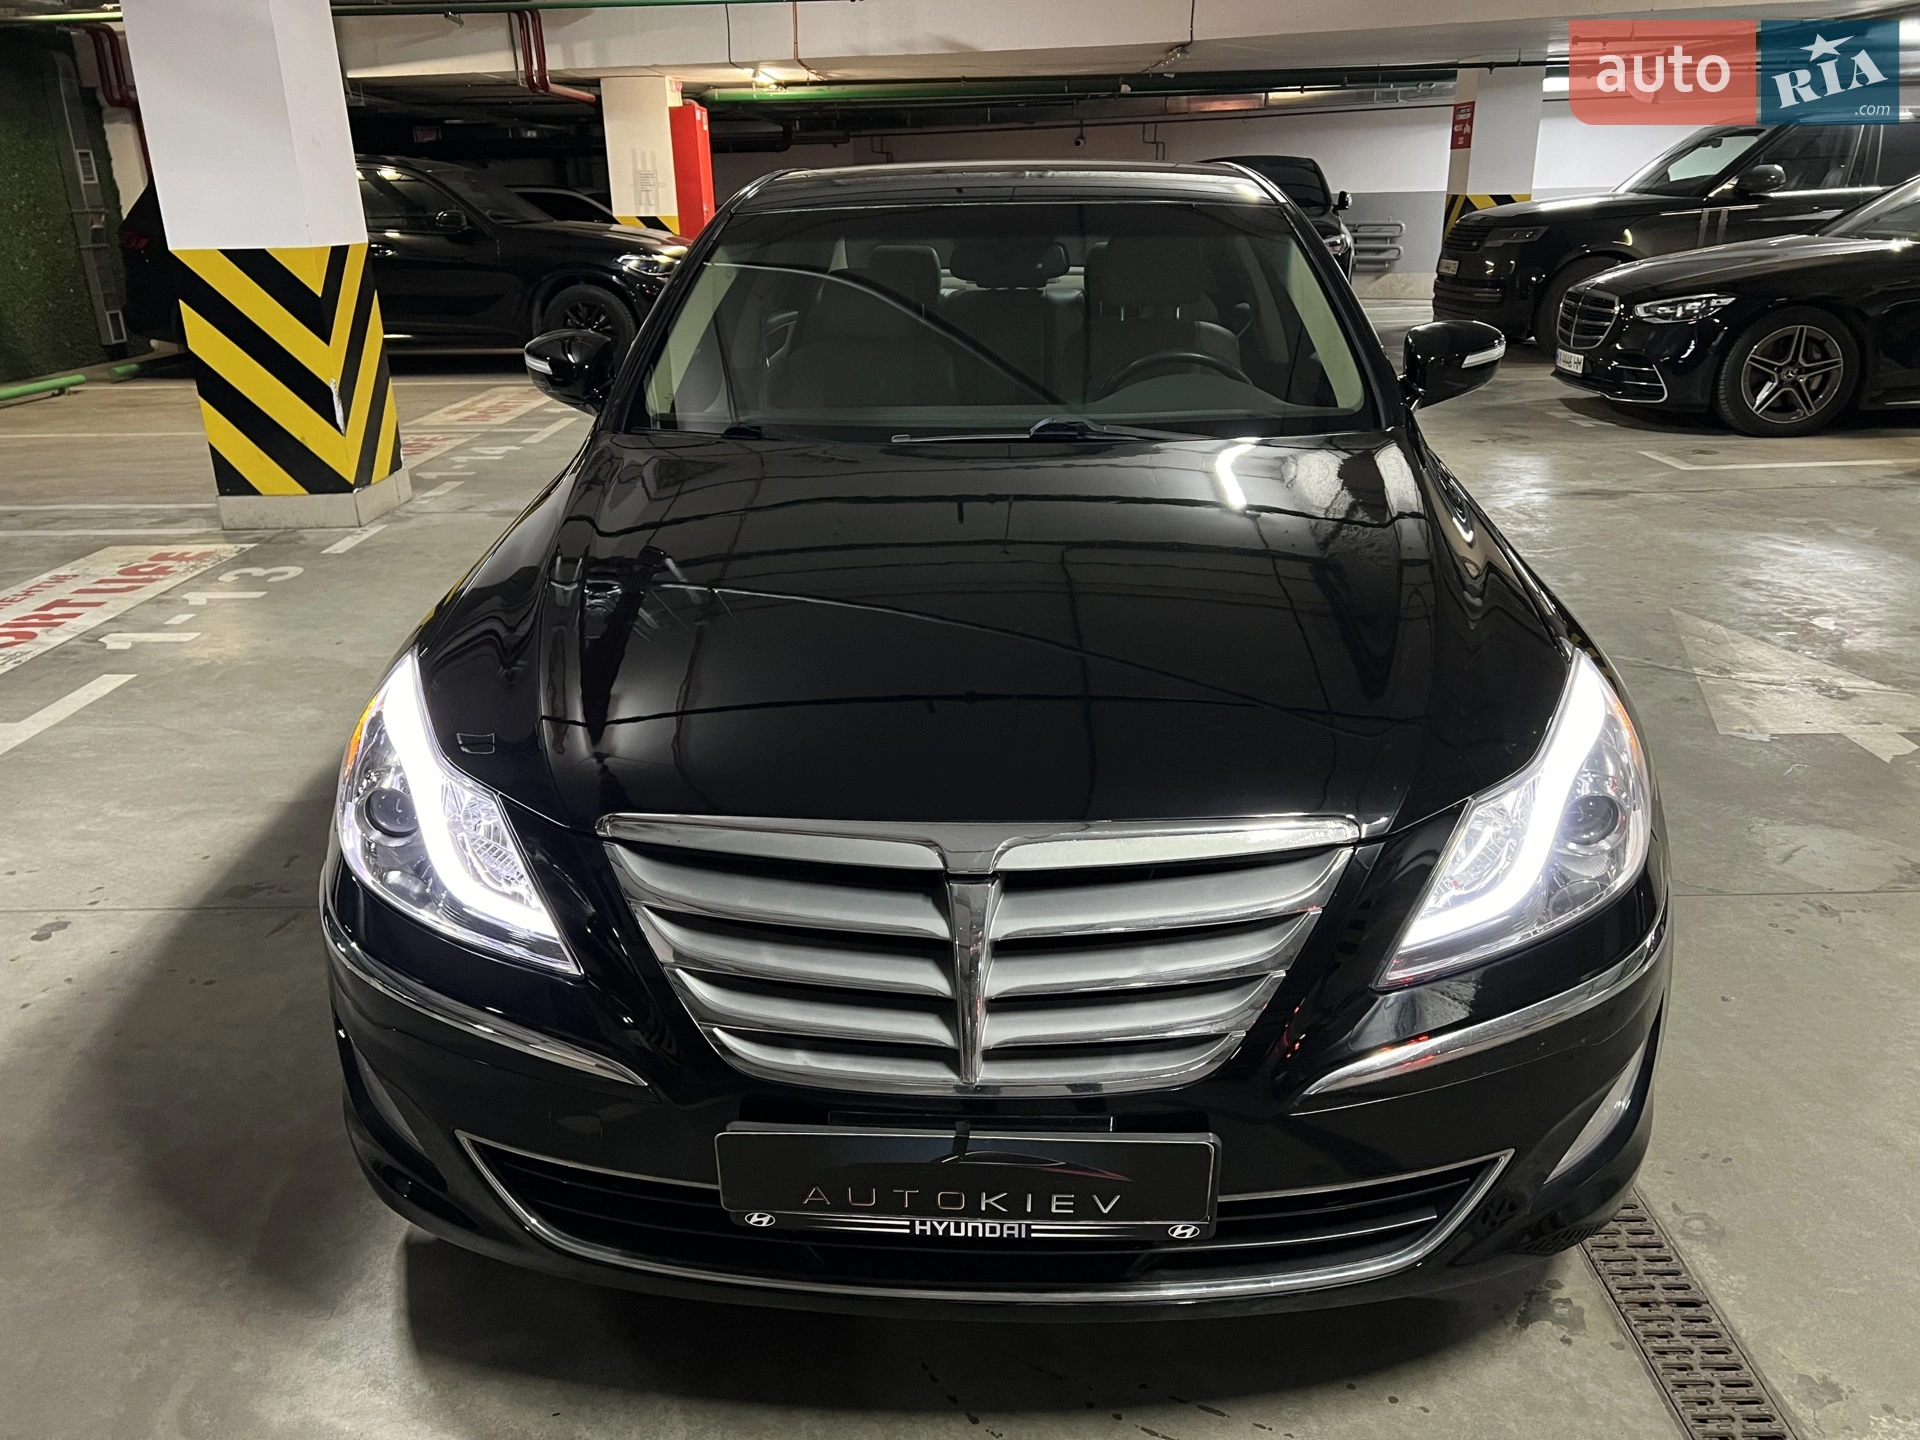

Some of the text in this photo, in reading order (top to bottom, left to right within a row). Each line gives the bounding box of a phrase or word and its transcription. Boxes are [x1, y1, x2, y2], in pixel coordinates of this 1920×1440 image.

[415, 445, 523, 480] 1-14
[97, 565, 305, 650] 1-13
[802, 1186, 1121, 1214] AUTOKIEV
[914, 1219, 1027, 1239] HYUNDAI
